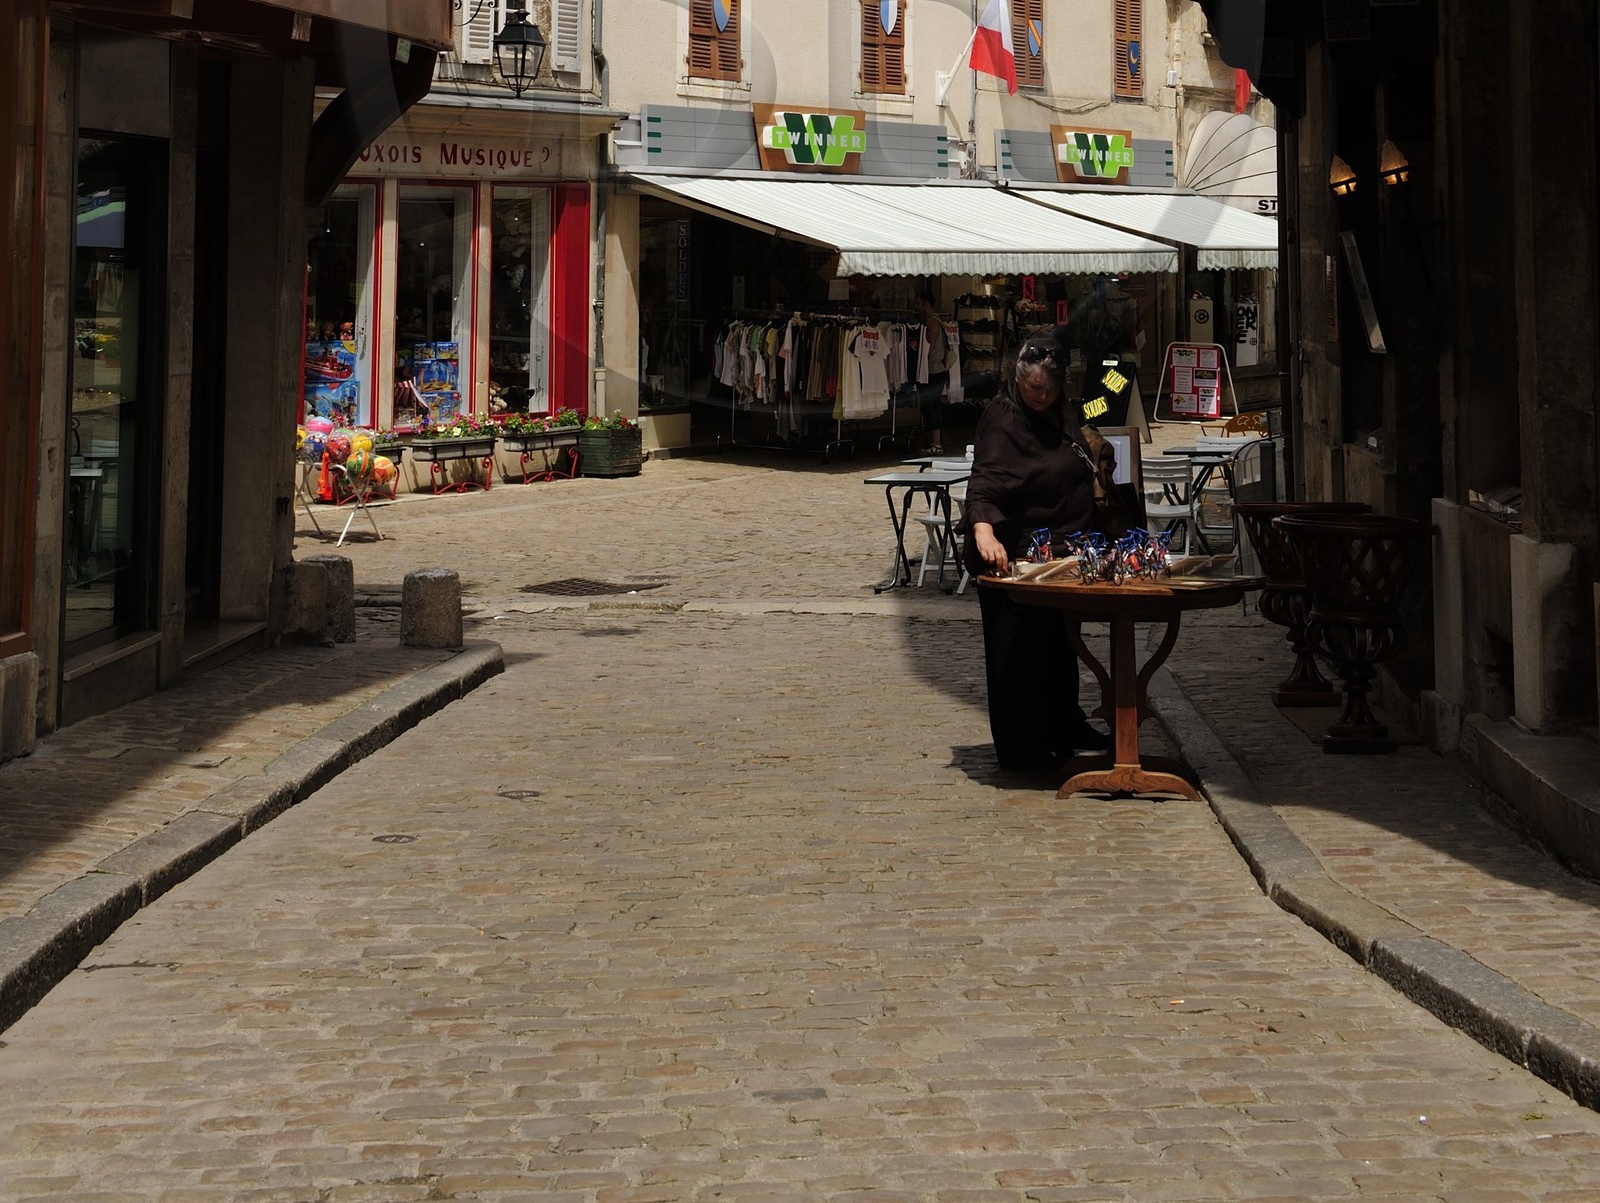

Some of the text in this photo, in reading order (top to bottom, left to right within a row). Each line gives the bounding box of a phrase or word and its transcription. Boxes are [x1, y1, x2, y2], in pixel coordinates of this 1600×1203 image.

[775, 130, 861, 148] TWINNER
[440, 142, 533, 170] MUSIQUE
[1068, 148, 1131, 164] TWINNER
[678, 223, 688, 299] SOLDES
[1083, 396, 1108, 420] SOLDES
